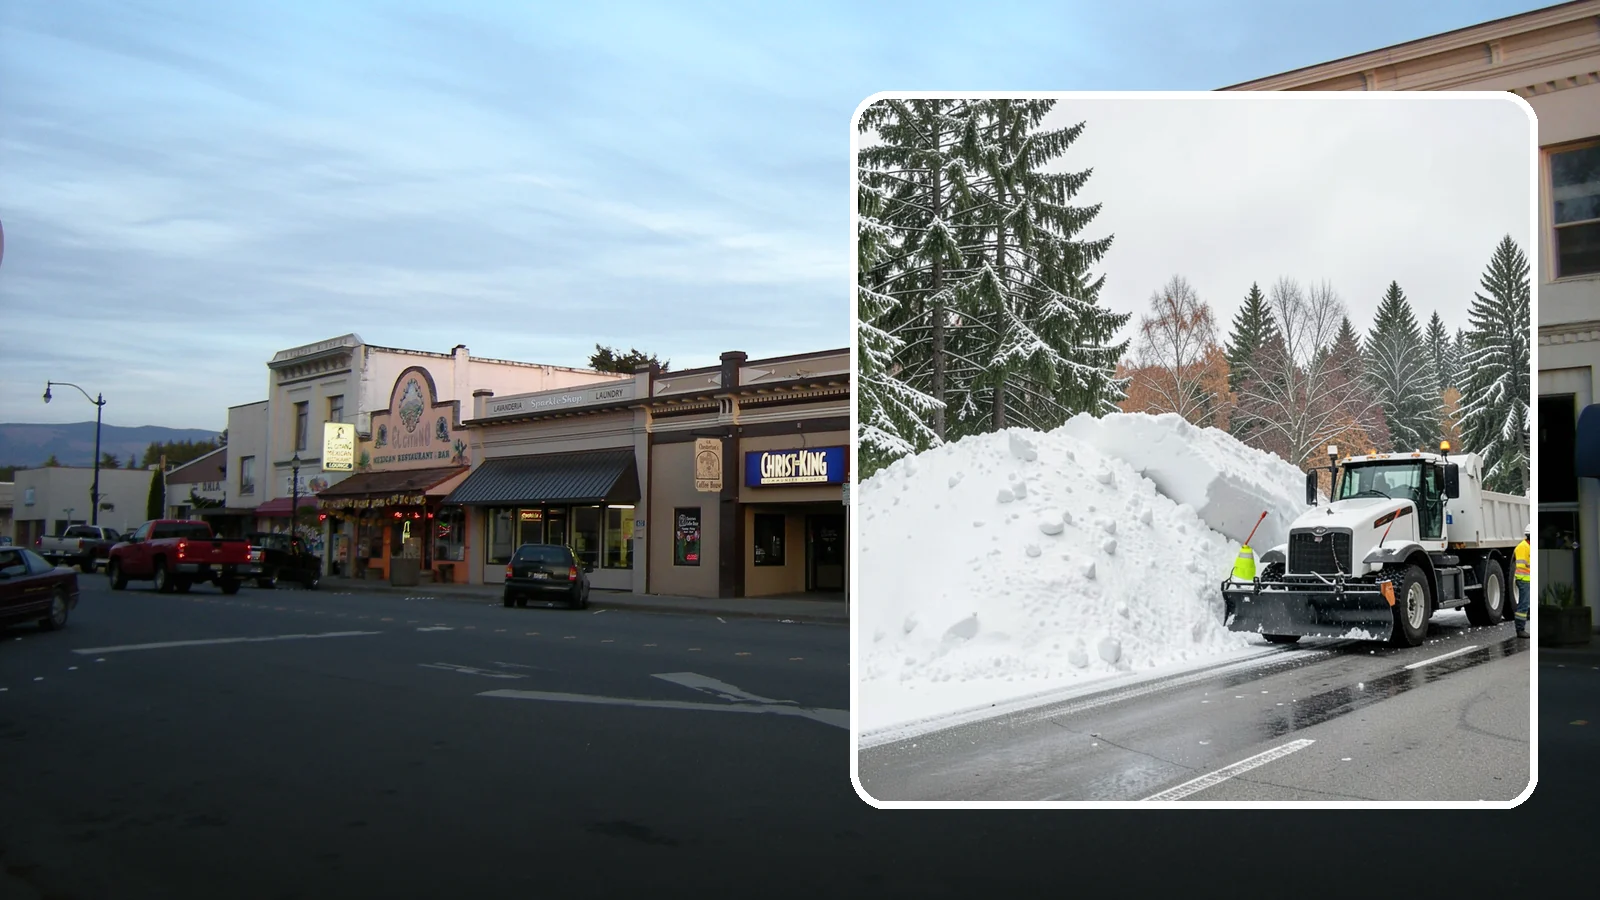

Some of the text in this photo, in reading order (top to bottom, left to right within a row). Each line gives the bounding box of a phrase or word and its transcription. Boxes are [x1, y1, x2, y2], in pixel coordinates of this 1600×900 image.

[595, 389, 623, 400] LAUNDRY
[493, 402, 522, 413] LAVANDERIA
[530, 394, 582, 409] Sparkle Shop
[373, 455, 396, 464] MEXICAN
[397, 451, 433, 462] RESTAURANT
[437, 450, 450, 459] BAR
[761, 450, 827, 478] CHRIST KING
[697, 480, 709, 488] Coffee
